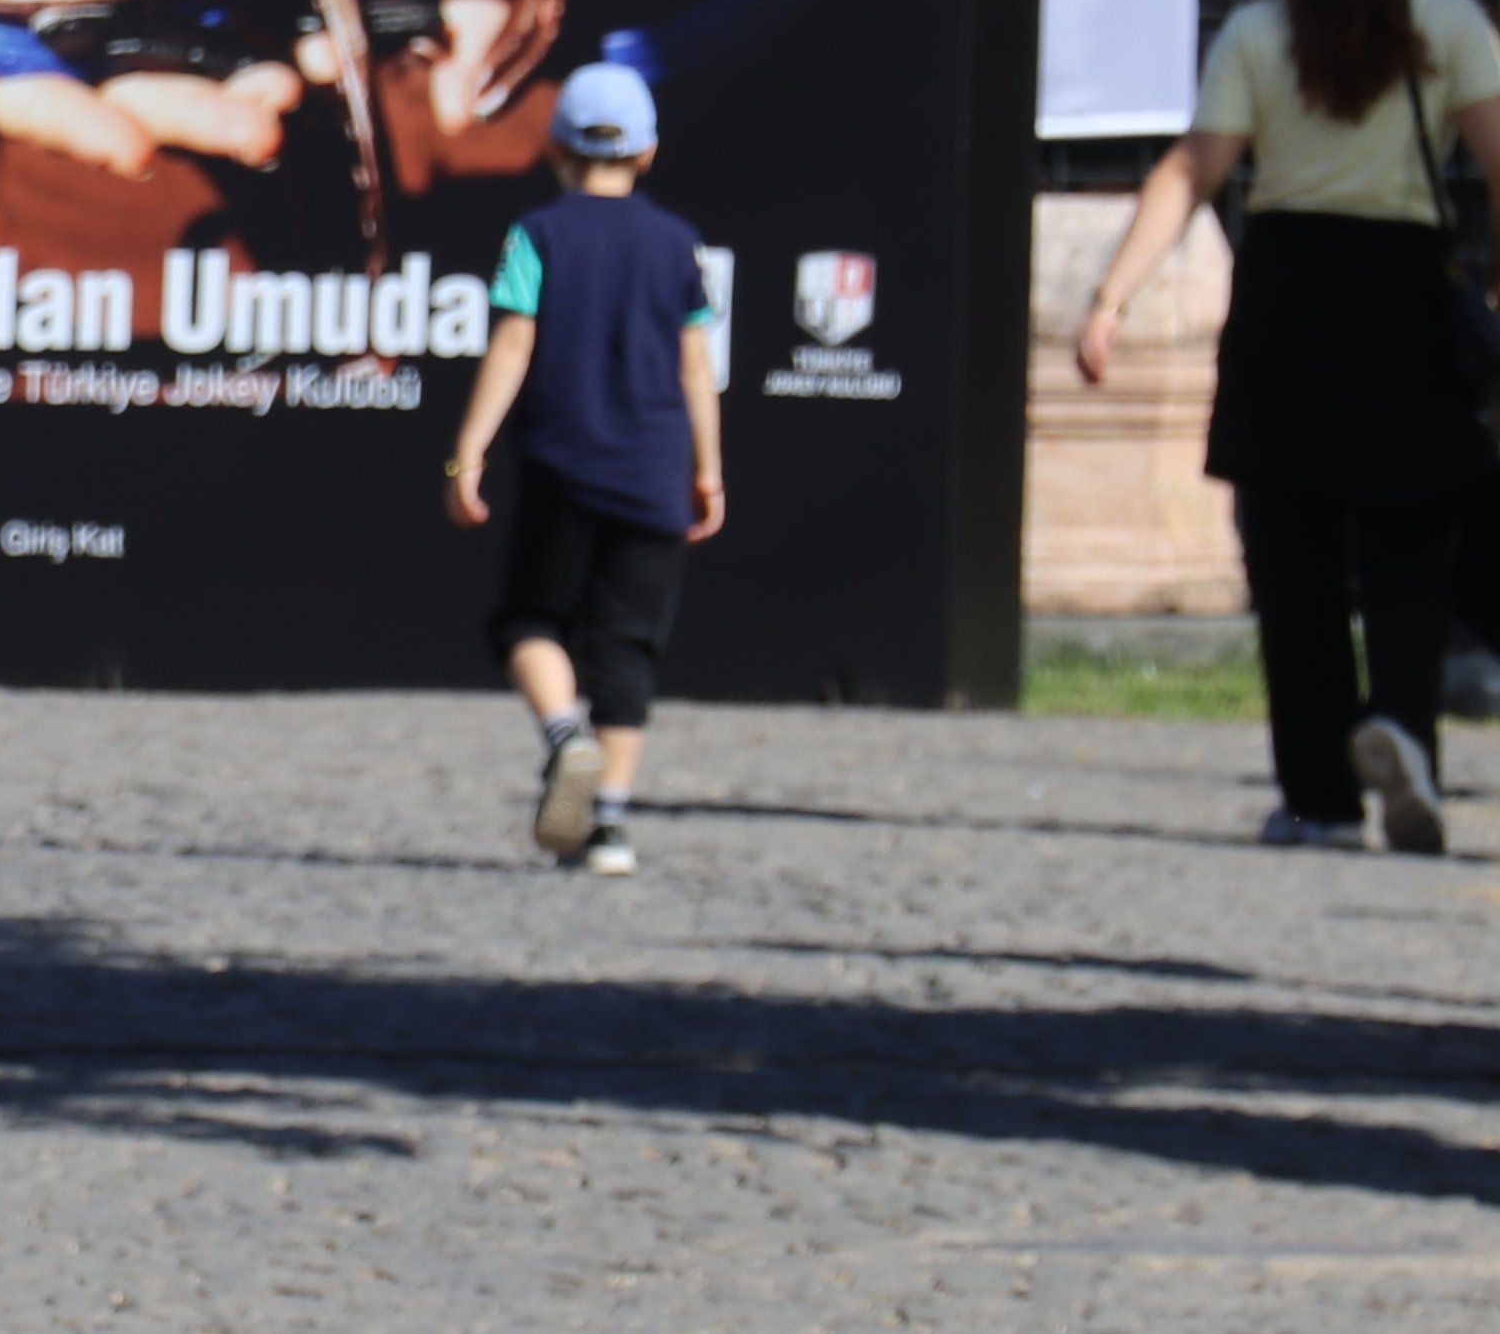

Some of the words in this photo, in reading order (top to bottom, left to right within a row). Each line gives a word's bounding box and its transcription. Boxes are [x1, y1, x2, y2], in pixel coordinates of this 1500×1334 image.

[160, 247, 490, 358] Umuda
[18, 361, 160, 415] Türkiye
[162, 364, 281, 417] Jokey
[285, 364, 422, 411] Kulübü
